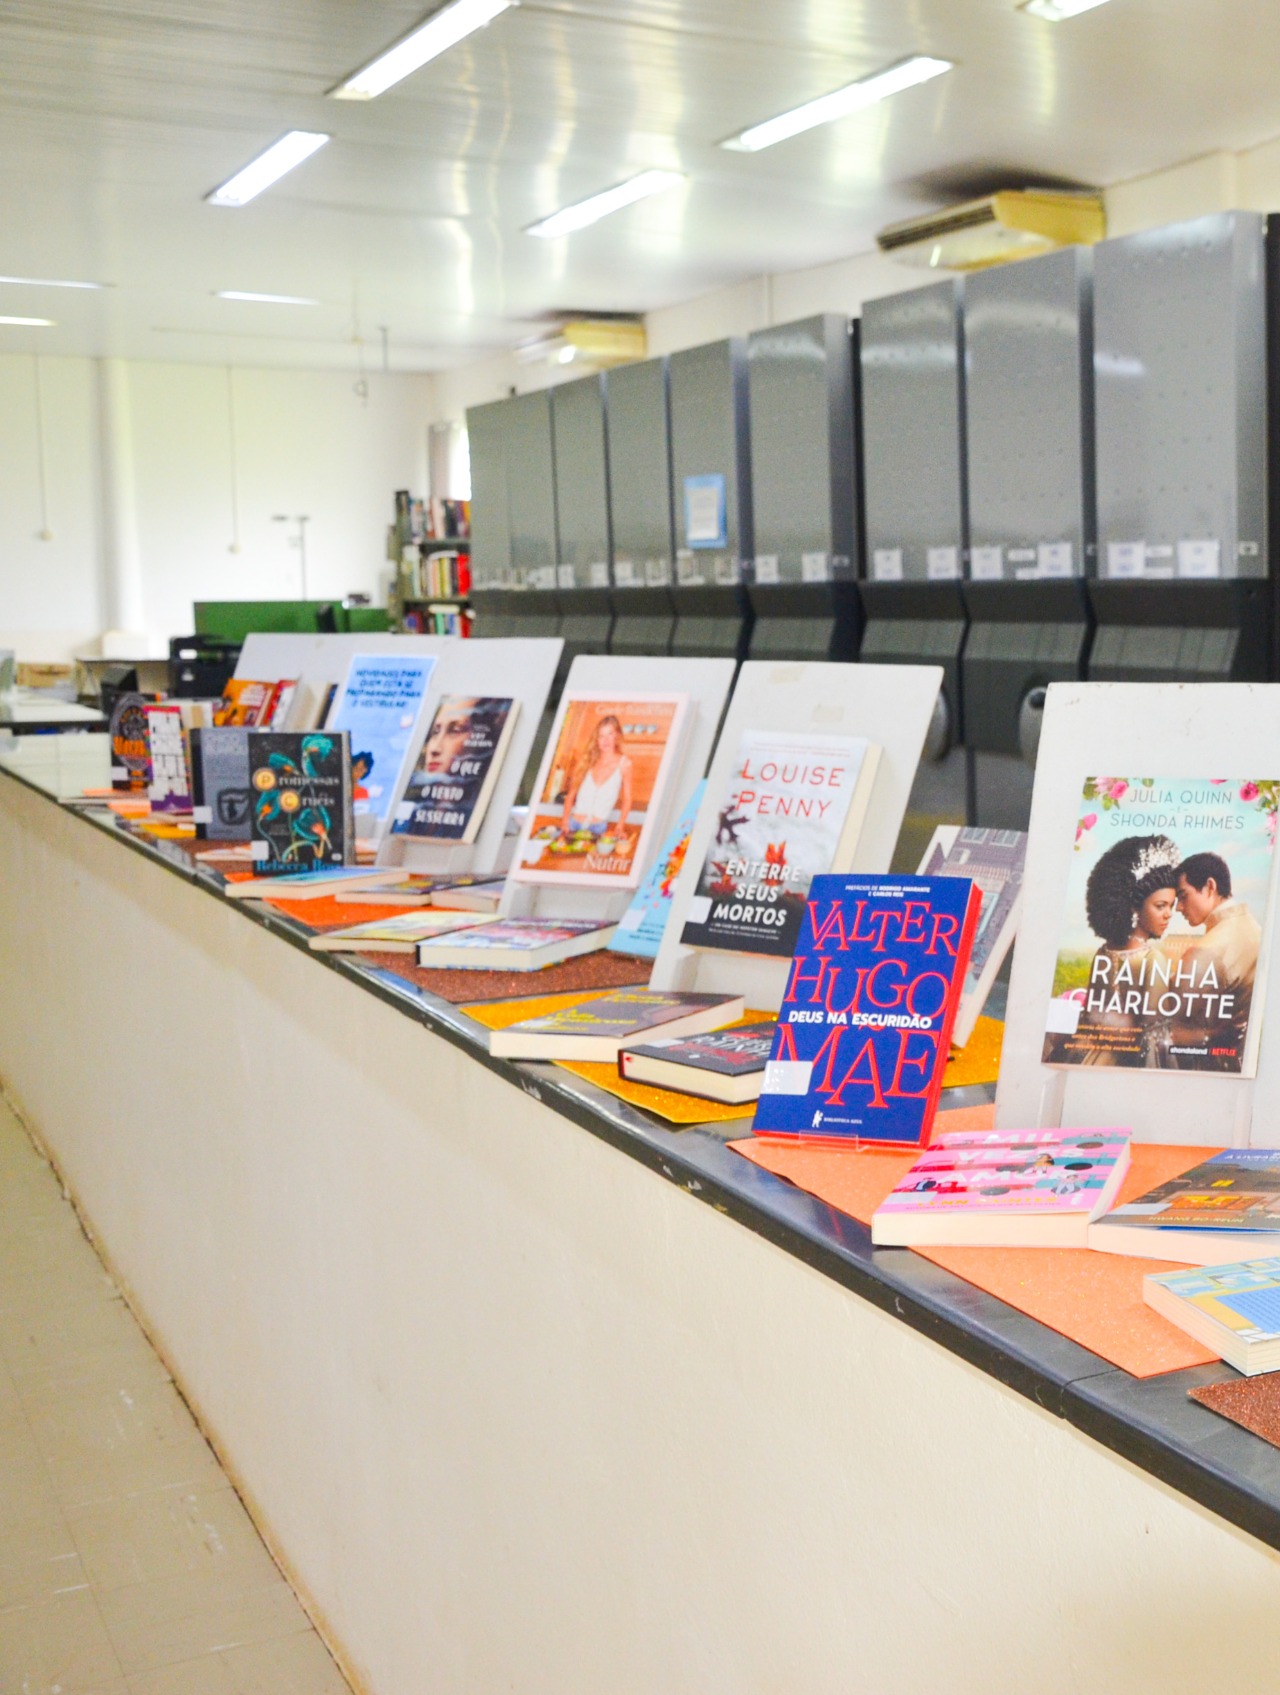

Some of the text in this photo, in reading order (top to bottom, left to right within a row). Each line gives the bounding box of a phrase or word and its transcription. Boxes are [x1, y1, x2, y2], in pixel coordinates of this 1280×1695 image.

[741, 759, 845, 787] LOUISE
[735, 791, 832, 819] PENNY
[1130, 789, 1232, 804] JULIA QUINN
[1110, 813, 1245, 830] SHONDA RHIMES
[584, 854, 631, 871] Nutrir
[725, 860, 801, 882] ENTERRE
[734, 883, 779, 902] SEUS
[713, 904, 787, 926] MORTOS
[807, 900, 960, 957] VALTER
[1091, 955, 1219, 989] RAINHA
[783, 956, 951, 1020] HUGO
[1068, 988, 1235, 1019] CHARLOTTE
[788, 1010, 932, 1030] DEUS NA ESCURIDÃO
[983, 1133, 1060, 1144] MIL
[957, 1149, 1085, 1161] VEZES
[940, 1170, 1078, 1183] AMOR
